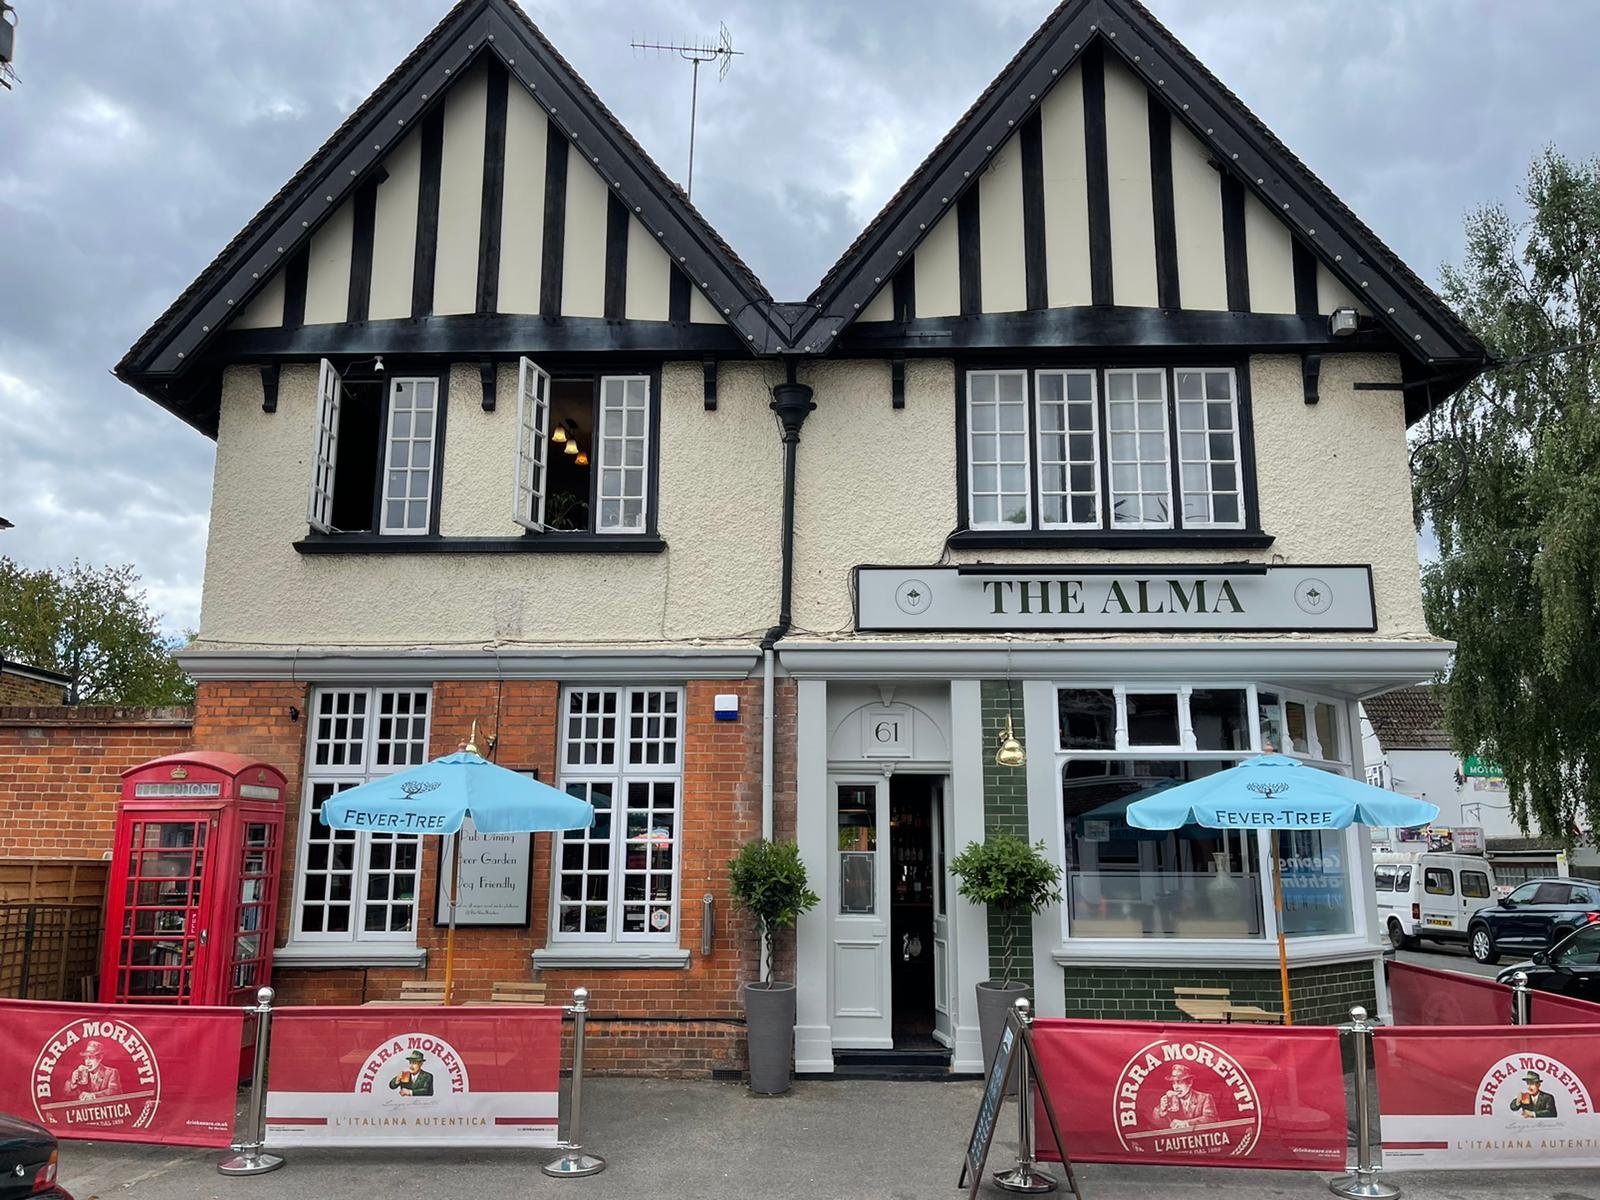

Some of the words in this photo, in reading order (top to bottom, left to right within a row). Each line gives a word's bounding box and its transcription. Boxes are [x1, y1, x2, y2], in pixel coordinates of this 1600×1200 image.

[983, 579, 1085, 614] THE
[1101, 578, 1245, 614] ALMA
[875, 721, 899, 743] 61
[137, 783, 219, 796] TPHONE
[343, 809, 446, 828] FEVER-TREE
[1216, 809, 1333, 826] FEVER-TREE
[480, 852, 517, 865] Garden
[479, 876, 516, 891] Friendly
[36, 1028, 81, 1098] BIRRA
[82, 1020, 155, 1085] MORETTI
[360, 1041, 404, 1094] BIRRA
[407, 1037, 464, 1094] MORETTI
[1121, 1053, 1164, 1127] BIRRA
[1162, 1043, 1255, 1112] MORETTI
[1480, 1062, 1518, 1116] BIRRA
[1519, 1057, 1588, 1115] MORETTI
[66, 1103, 132, 1124] L'AUTENTICA
[336, 1117, 407, 1126] L'ITALIANA
[415, 1116, 487, 1126] AUTENTICA
[1154, 1131, 1230, 1152] L'AUTENTICA
[1457, 1140, 1532, 1150] L'ITALIANA
